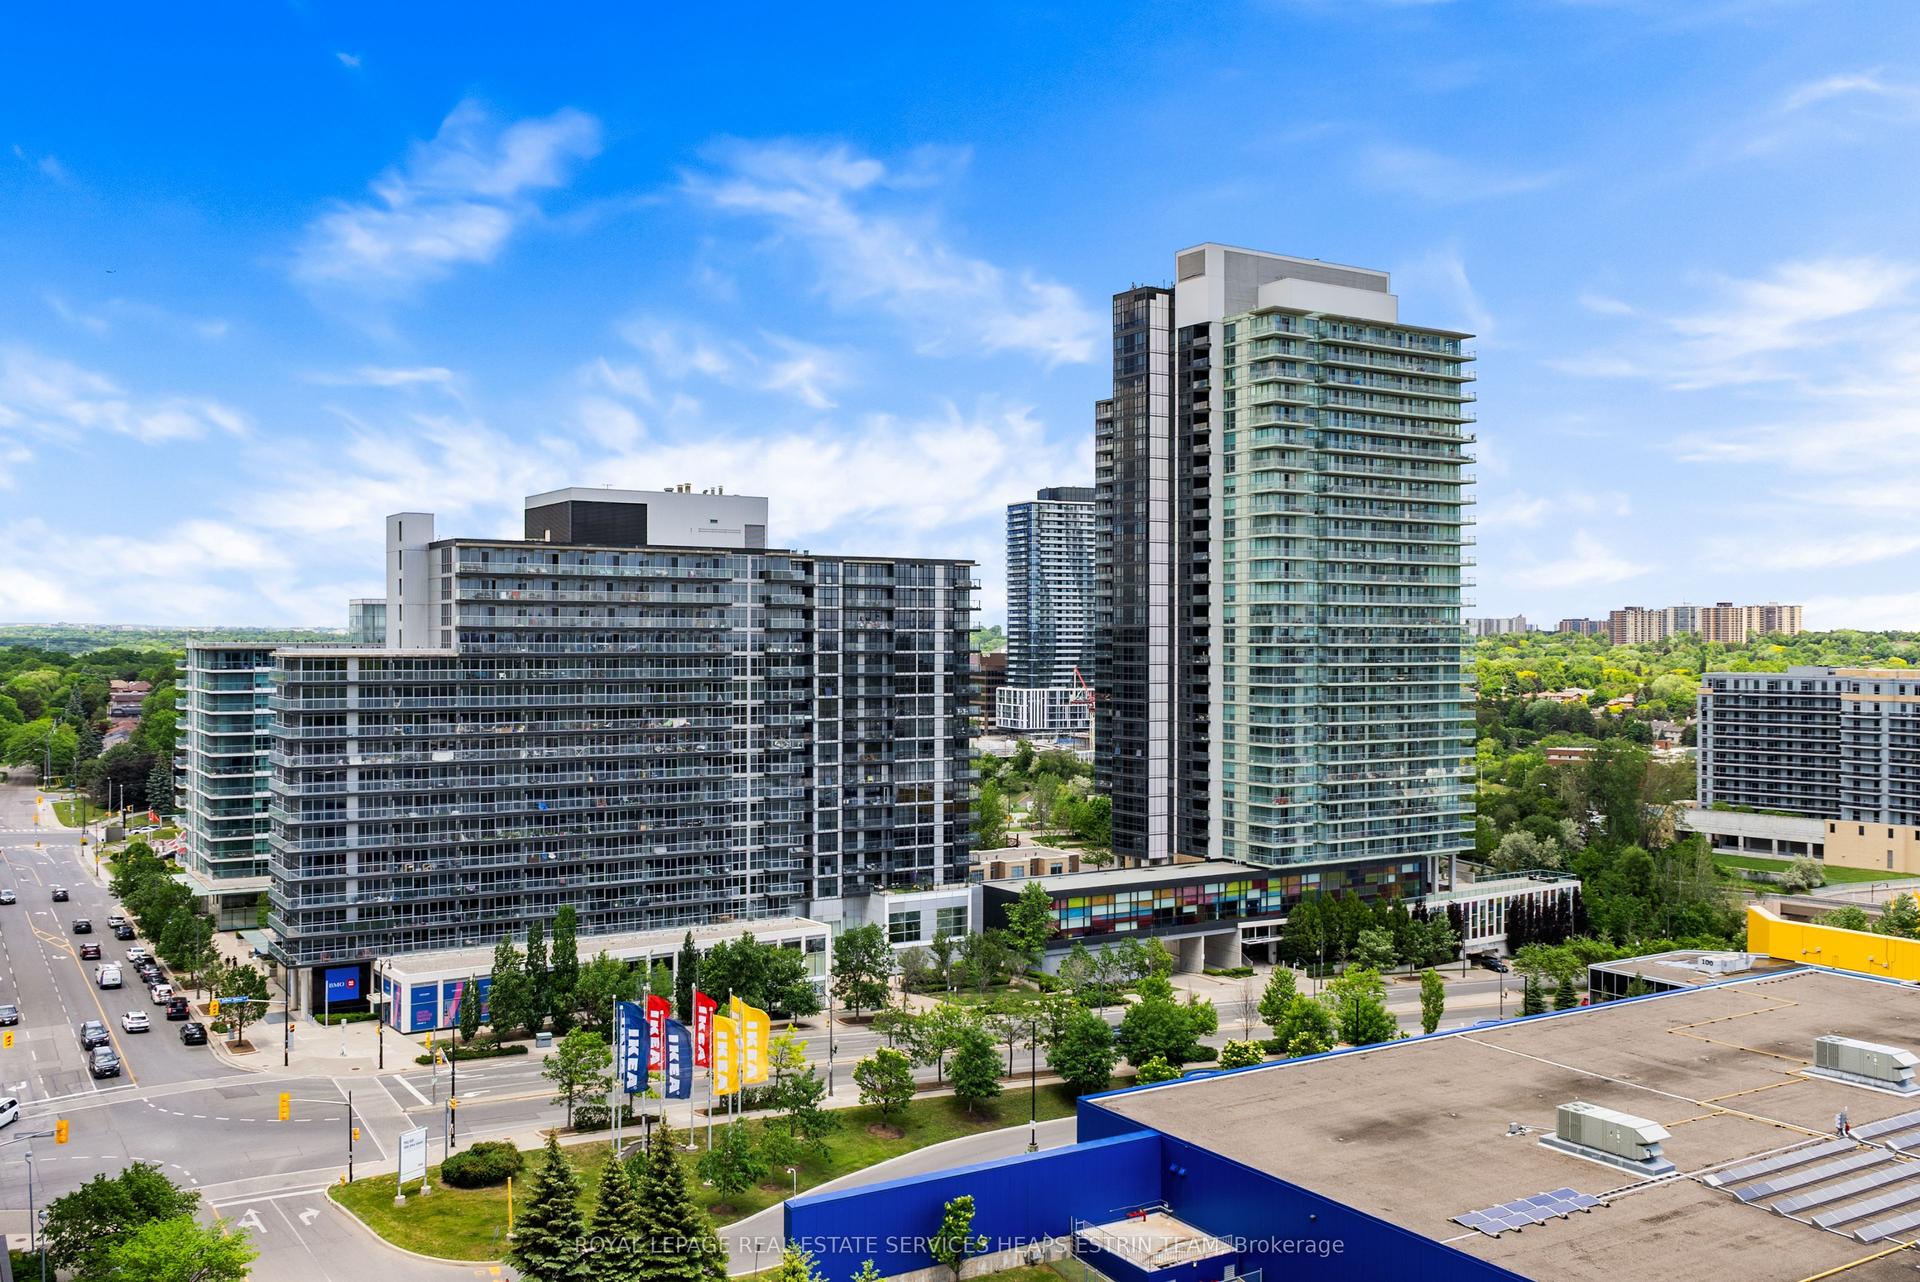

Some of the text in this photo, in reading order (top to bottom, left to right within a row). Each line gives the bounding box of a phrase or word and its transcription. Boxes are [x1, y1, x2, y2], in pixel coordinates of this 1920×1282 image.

[626, 1028, 640, 1089] IKEA
[649, 1010, 661, 1066] IKEA
[697, 1006, 708, 1062] IKEA
[716, 1031, 728, 1090] IKEA
[746, 1021, 758, 1078] IKEA
[668, 1034, 680, 1094] IKEA
